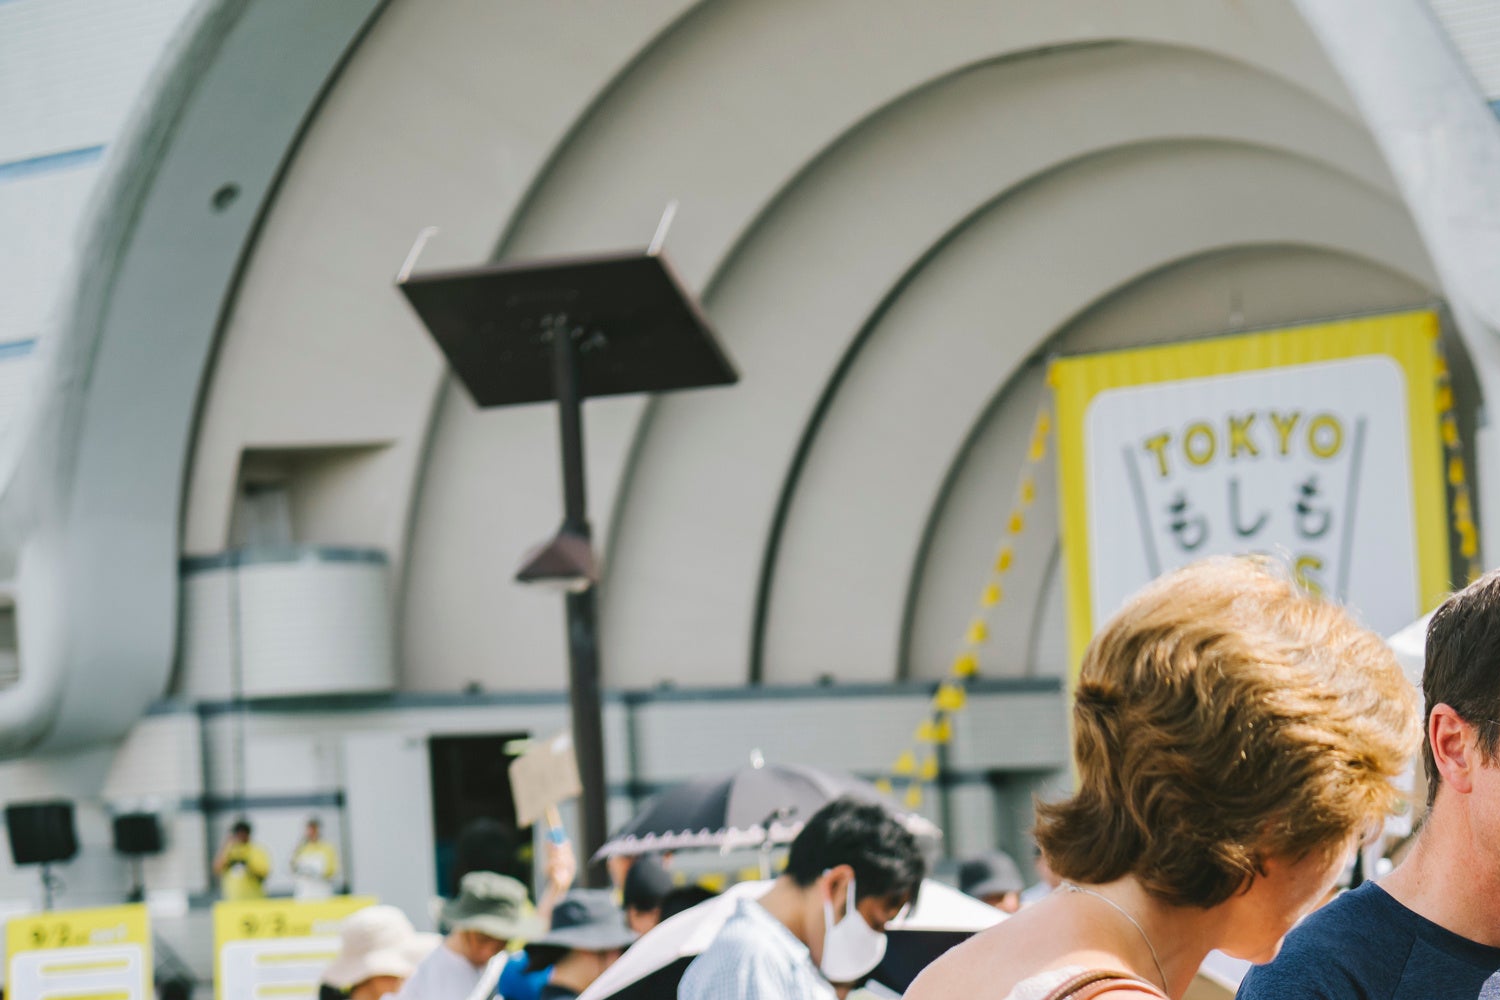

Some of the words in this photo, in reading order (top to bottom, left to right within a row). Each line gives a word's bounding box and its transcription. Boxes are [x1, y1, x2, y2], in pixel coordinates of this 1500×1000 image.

[1143, 411, 1345, 477] TOKYO
[1168, 476, 1333, 550] もしも
